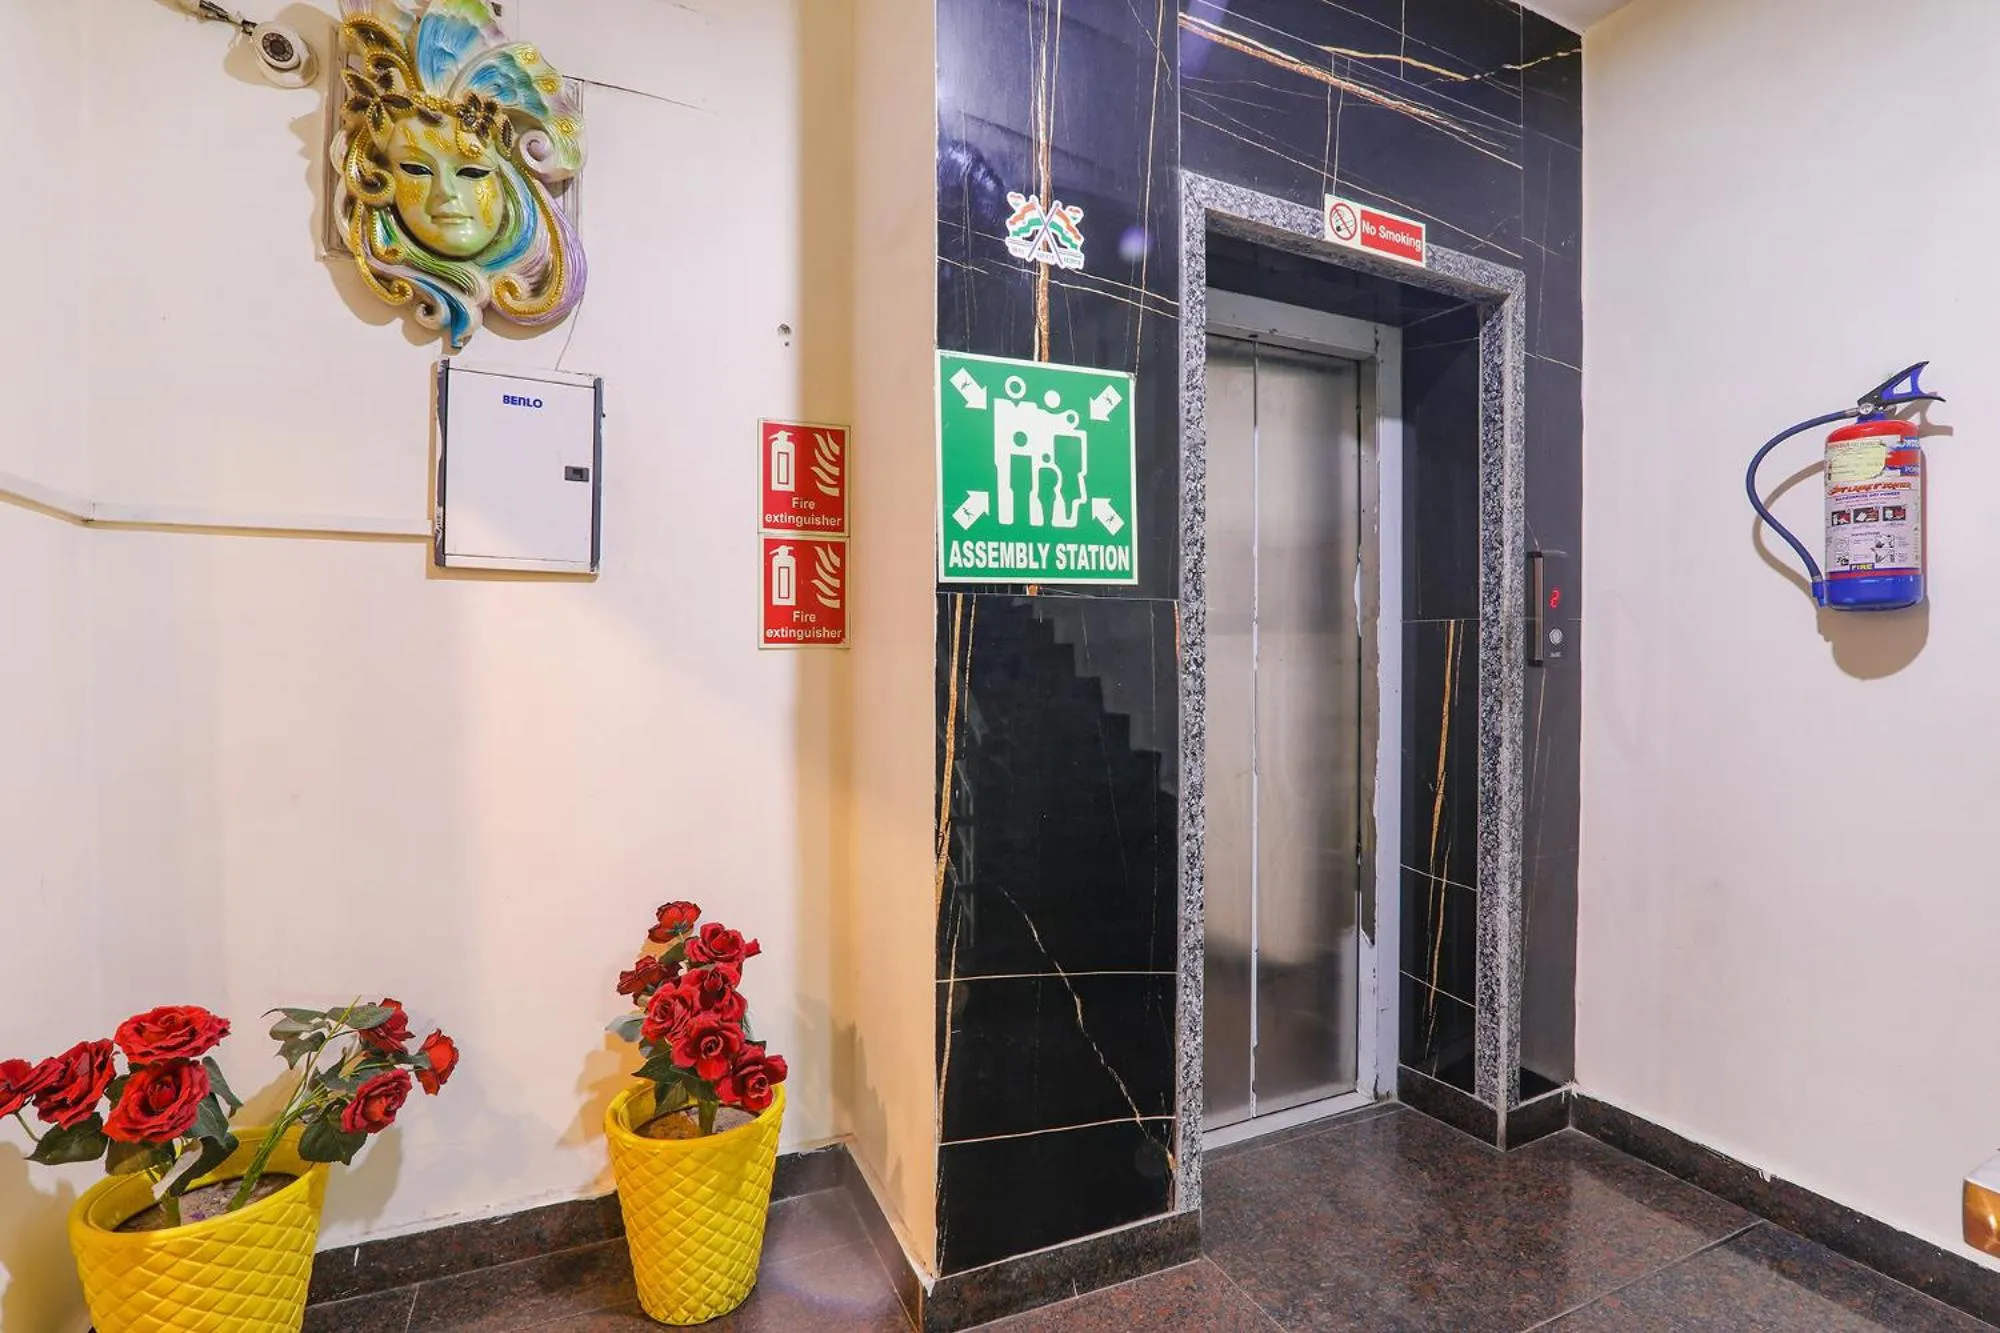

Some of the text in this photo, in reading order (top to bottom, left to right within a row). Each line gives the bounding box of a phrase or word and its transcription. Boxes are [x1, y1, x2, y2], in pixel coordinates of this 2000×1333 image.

[1361, 220, 1422, 253] No Smoking
[502, 395, 543, 409] BENLO
[792, 496, 816, 510] Fire
[765, 513, 842, 528] extinguisher
[949, 540, 1130, 571] ASSEMBLY STATION
[1549, 589, 1561, 608] 2
[792, 610, 816, 623] Fire
[765, 623, 842, 640] extinguisher
